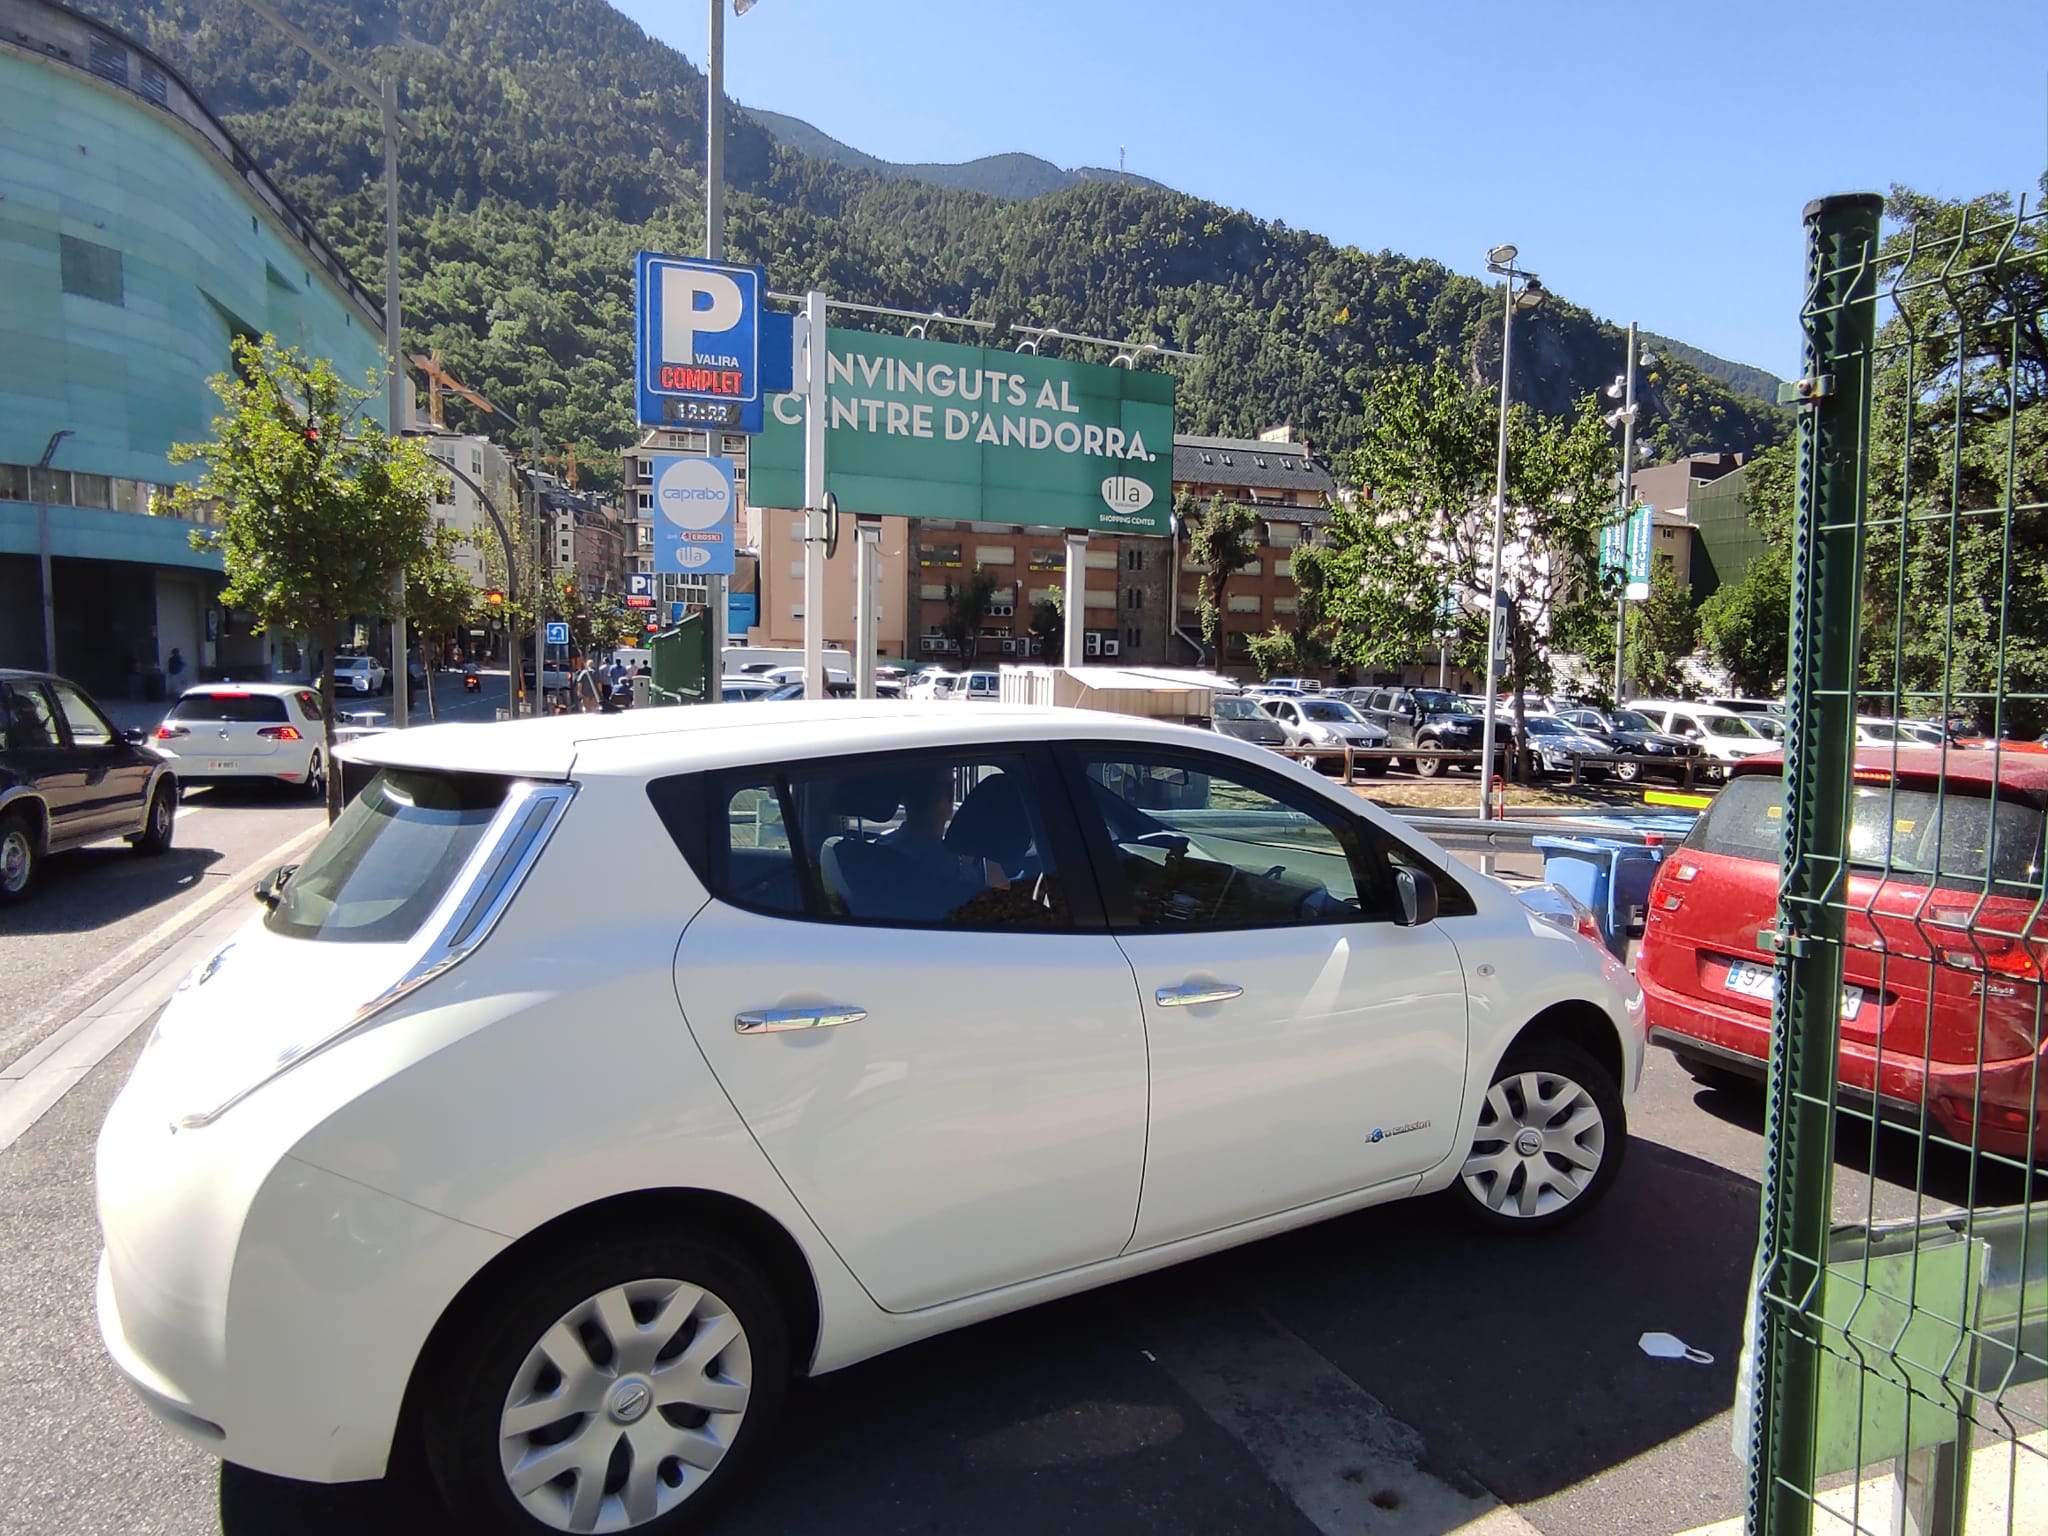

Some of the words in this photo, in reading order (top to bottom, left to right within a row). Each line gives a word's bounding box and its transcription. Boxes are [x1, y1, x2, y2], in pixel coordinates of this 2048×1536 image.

[662, 266, 743, 365] P
[695, 353, 740, 368] VALIRA
[661, 366, 743, 394] COMPLET
[827, 350, 1026, 407] NVINGUTS
[1035, 378, 1080, 414] AL
[772, 392, 934, 439] CNTRE
[662, 487, 726, 502] caprabo
[1108, 475, 1140, 503] illa
[1131, 517, 1156, 526] CENTER
[680, 546, 702, 561] illa
